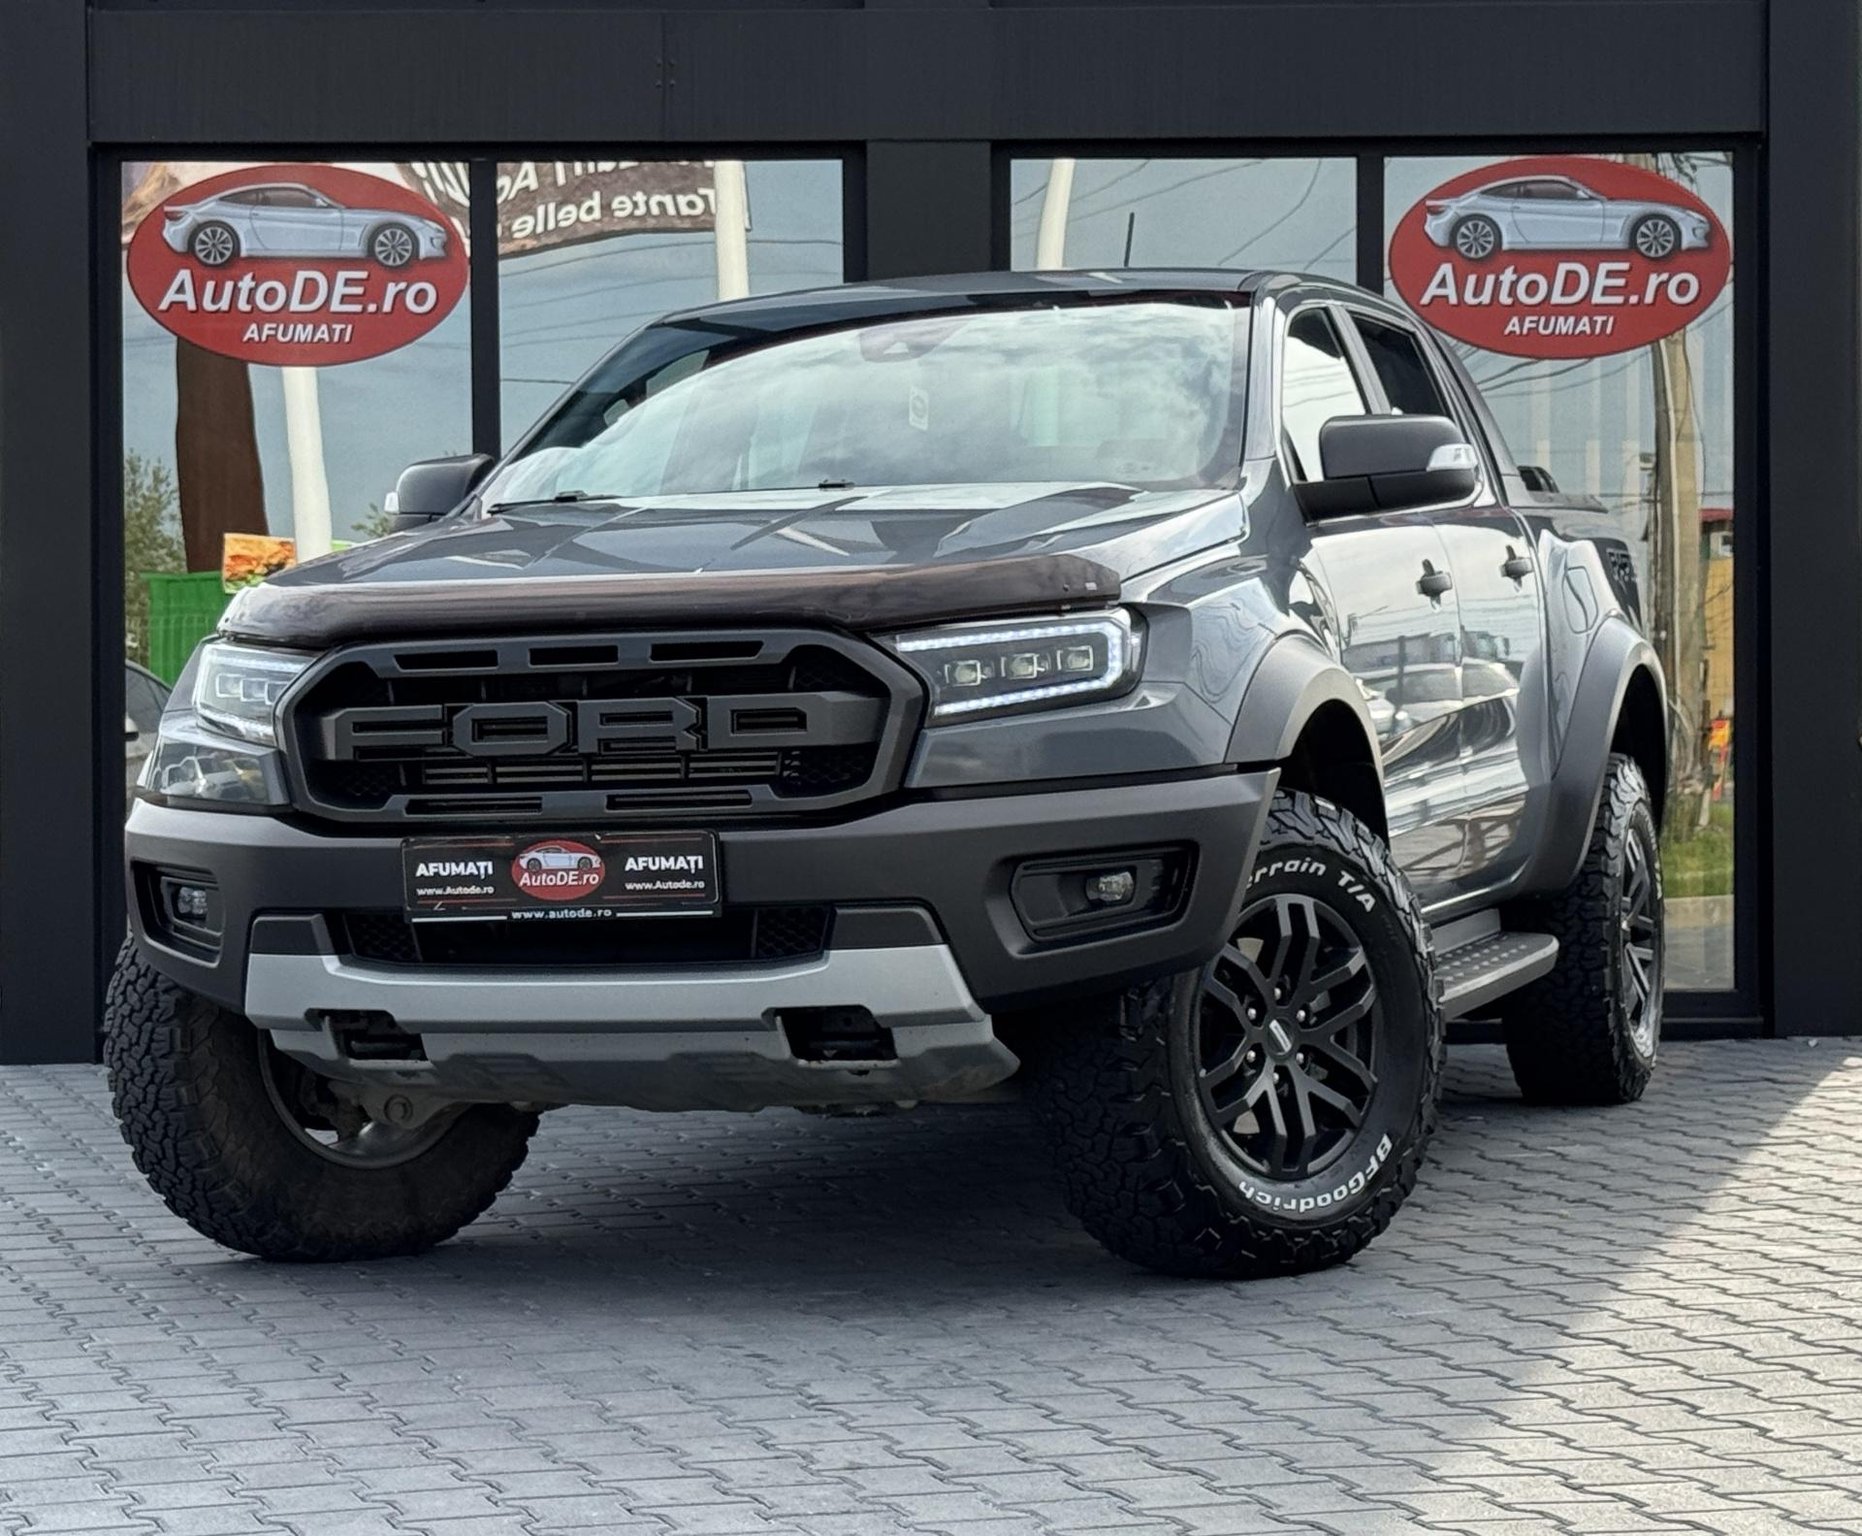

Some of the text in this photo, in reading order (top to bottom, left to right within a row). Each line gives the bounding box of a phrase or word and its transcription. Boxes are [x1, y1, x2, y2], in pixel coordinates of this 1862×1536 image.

[158, 268, 438, 314] AutoDE.ro
[1419, 262, 1700, 306] AutoDE.ro
[242, 323, 353, 343] AFUMATI
[1503, 315, 1614, 336] AFUMATI
[321, 691, 888, 762] FORD
[518, 870, 600, 887] AutoDE.ro
[1337, 870, 1376, 913] T/A
[511, 908, 613, 919] www.autode.ro
[1238, 1133, 1393, 1213] BFGoodrich
